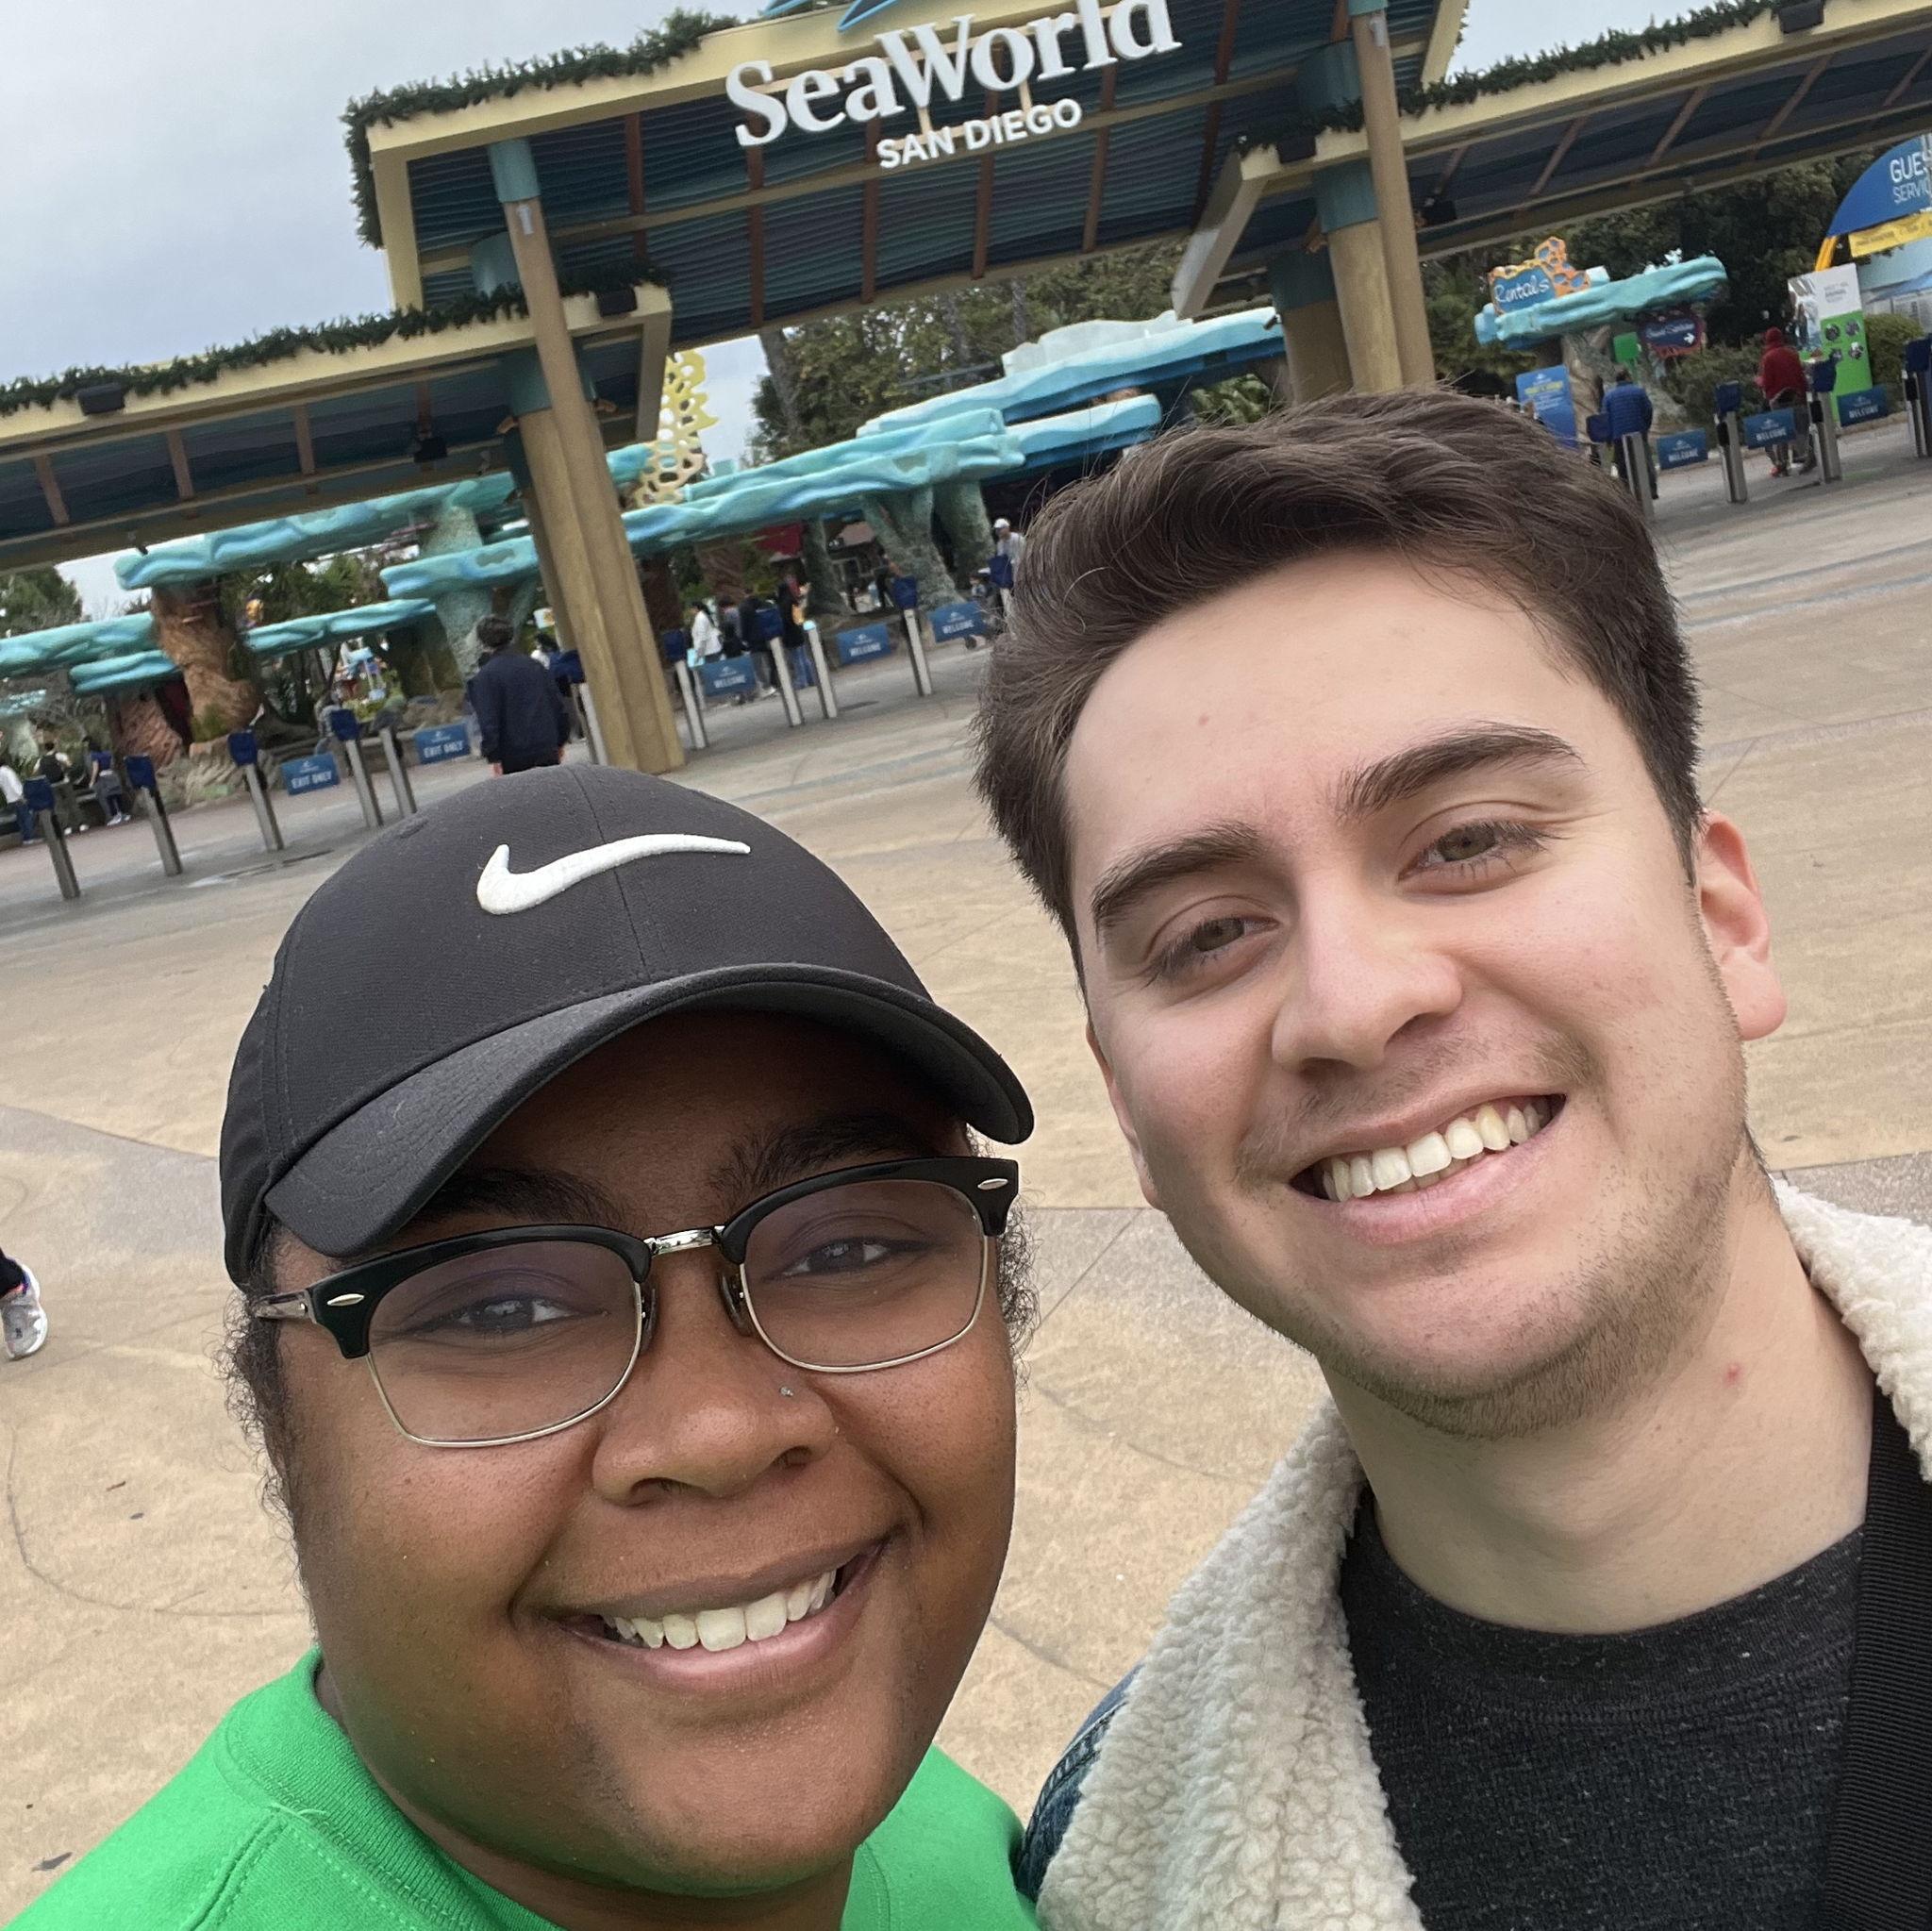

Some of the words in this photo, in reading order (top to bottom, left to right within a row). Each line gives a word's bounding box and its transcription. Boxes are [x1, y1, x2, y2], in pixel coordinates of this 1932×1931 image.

[725, 0, 1182, 147] SeaWorld
[876, 132, 956, 169] SAN
[963, 98, 1082, 151] DIEGO
[1494, 275, 1550, 302] Rentals
[1756, 427, 1787, 441] WELCOME
[1668, 448, 1699, 462] WELCOME
[941, 619, 974, 634] WELCOME
[849, 641, 882, 657] WELCOME
[714, 674, 746, 689] WELCOME
[424, 745, 442, 758] EXIT
[443, 741, 463, 754] ONLY
[291, 774, 310, 790] EXIT
[311, 771, 332, 784] ONLY
